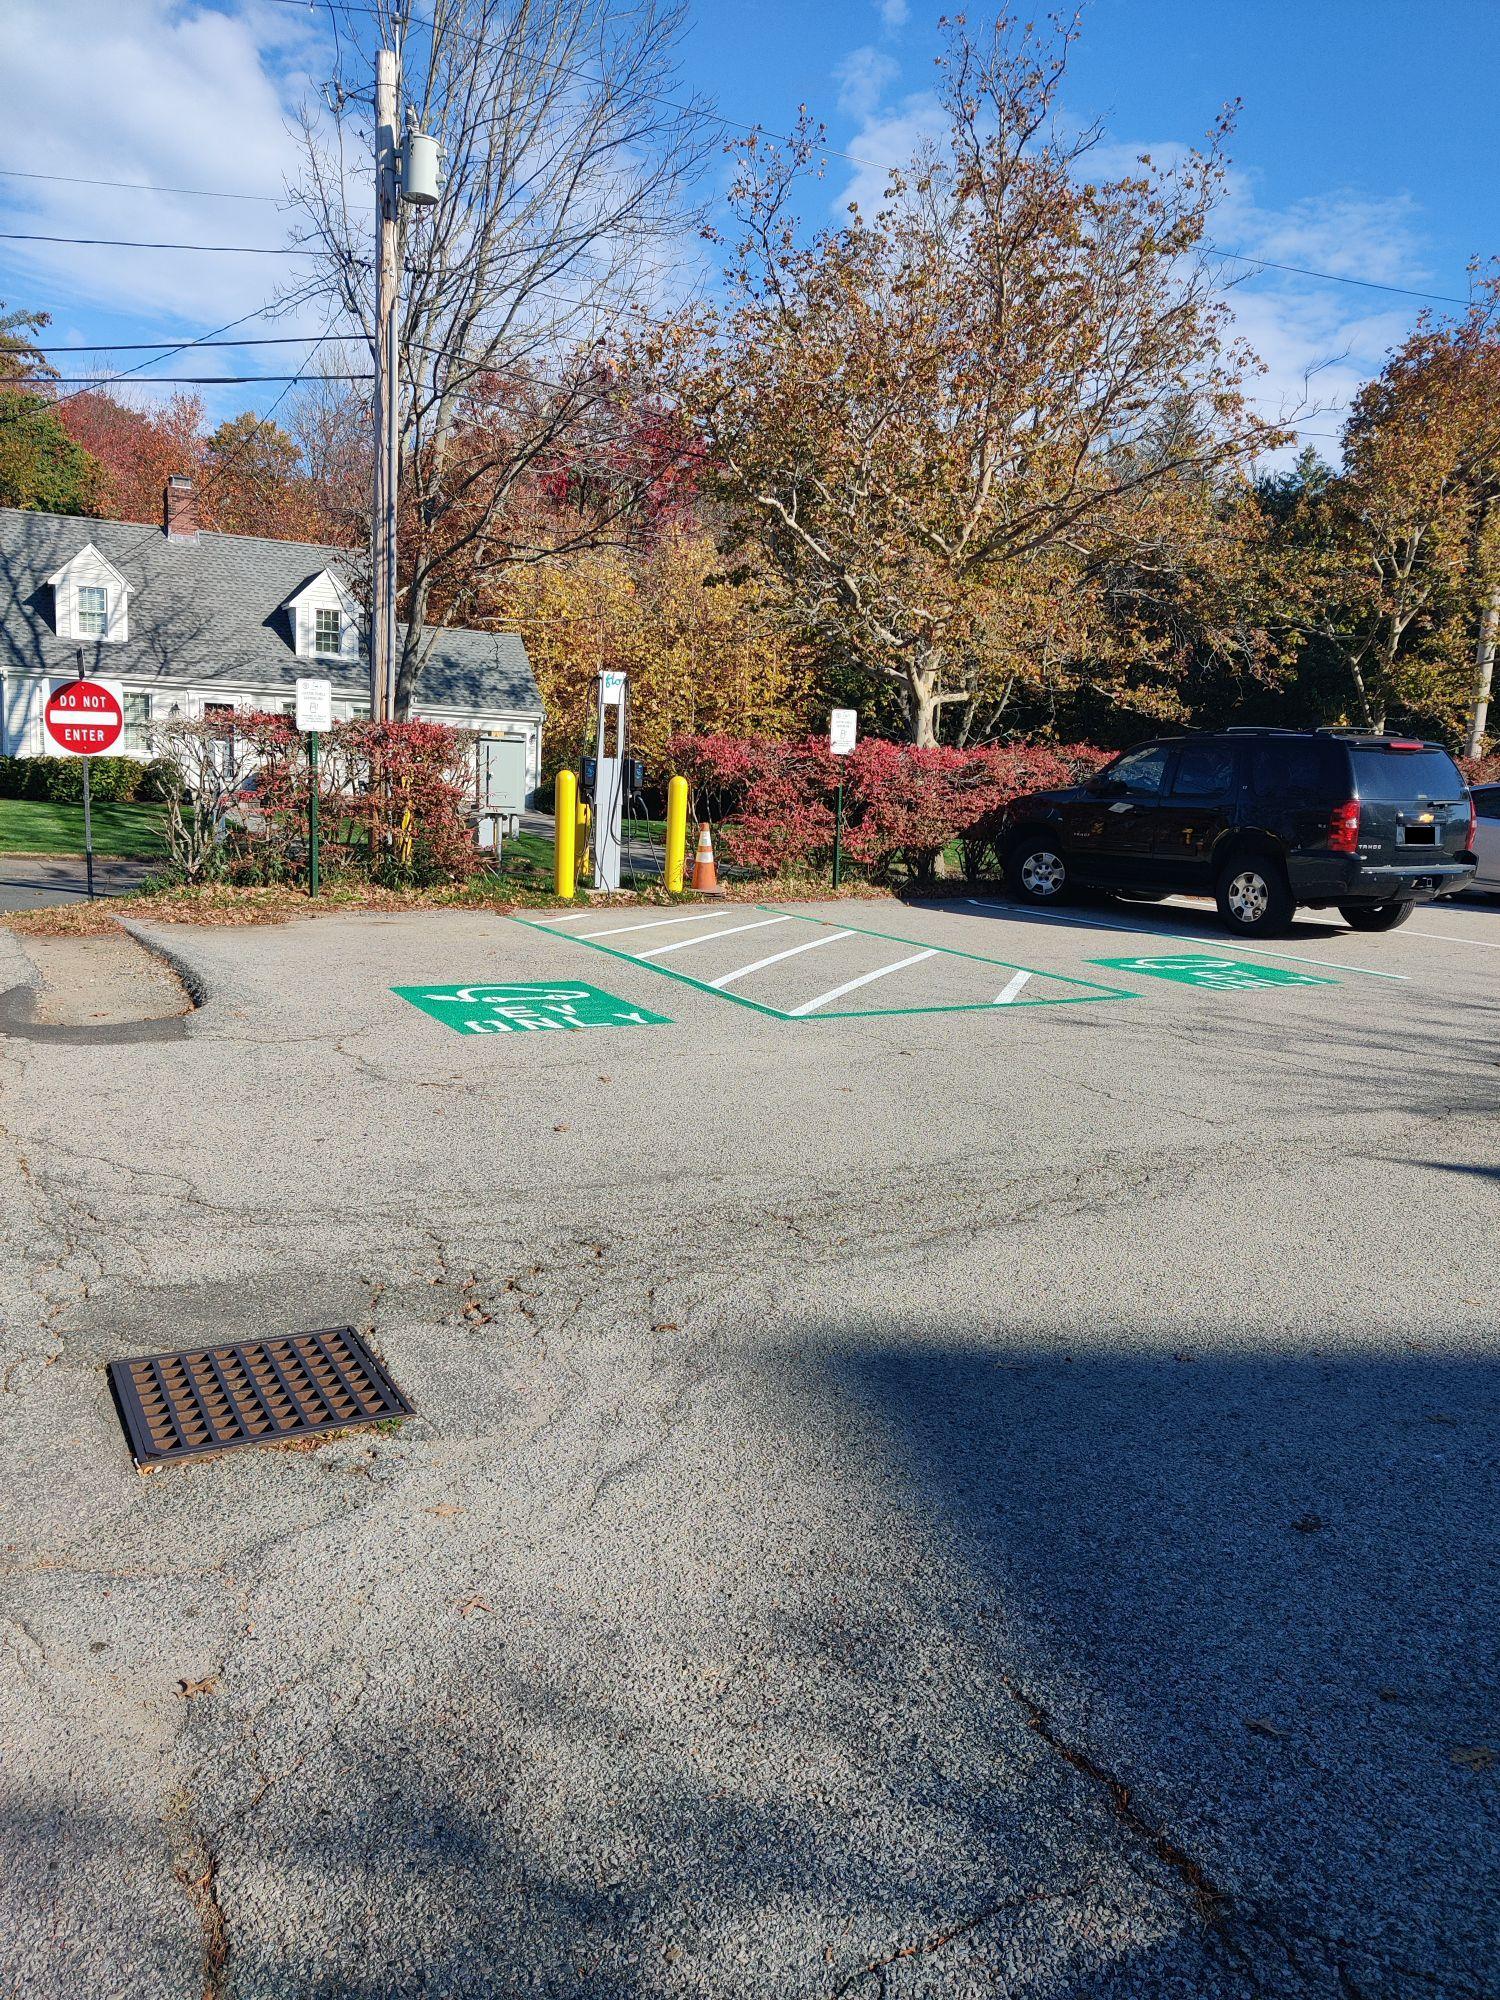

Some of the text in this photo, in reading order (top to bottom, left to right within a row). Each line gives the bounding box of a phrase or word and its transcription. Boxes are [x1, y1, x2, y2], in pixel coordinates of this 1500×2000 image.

[60, 694, 106, 708] DO NOT
[65, 729, 104, 741] ENTER
[492, 1004, 576, 1018] EV
[464, 1012, 648, 1033] ONLY
